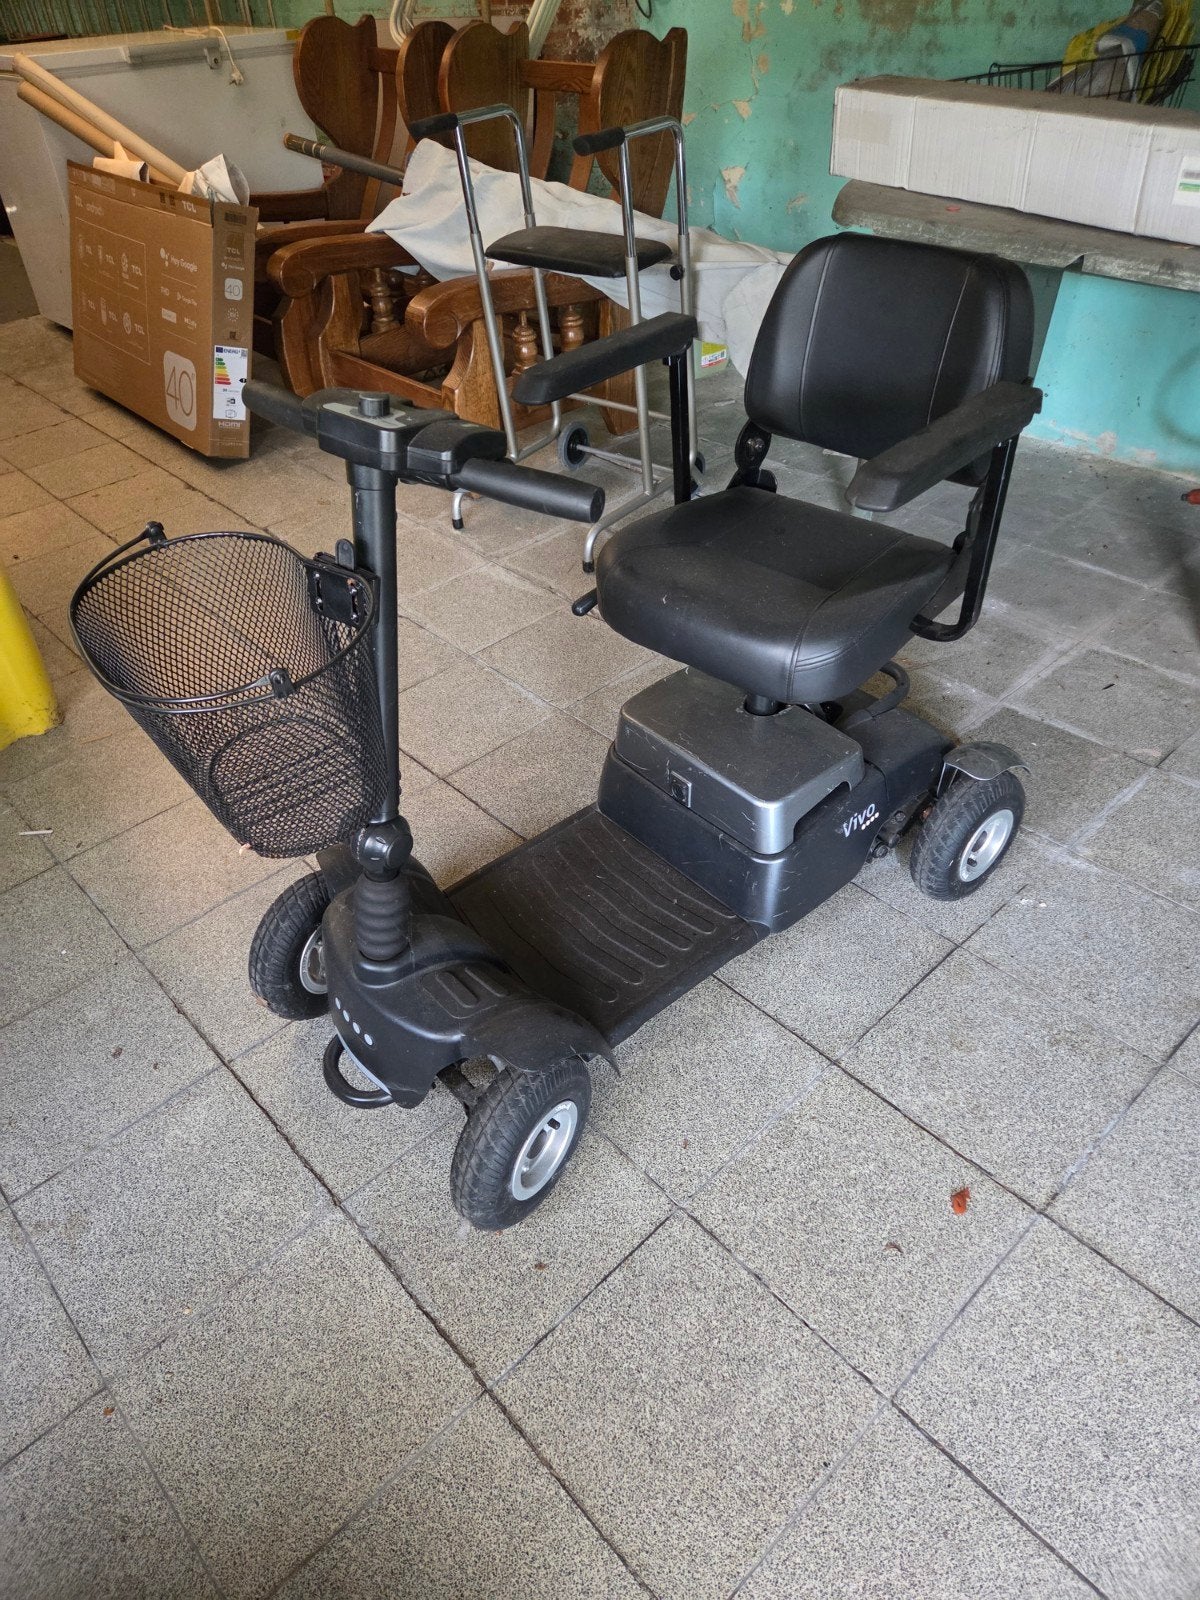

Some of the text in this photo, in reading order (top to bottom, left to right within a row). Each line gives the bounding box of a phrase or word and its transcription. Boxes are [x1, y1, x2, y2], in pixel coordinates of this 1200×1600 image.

[181, 200, 197, 214] TCL
[226, 247, 241, 255] TCL
[170, 254, 198, 273] Hey Google
[131, 264, 142, 276] TCL
[108, 310, 118, 322] TCL
[134, 323, 145, 336] TCL
